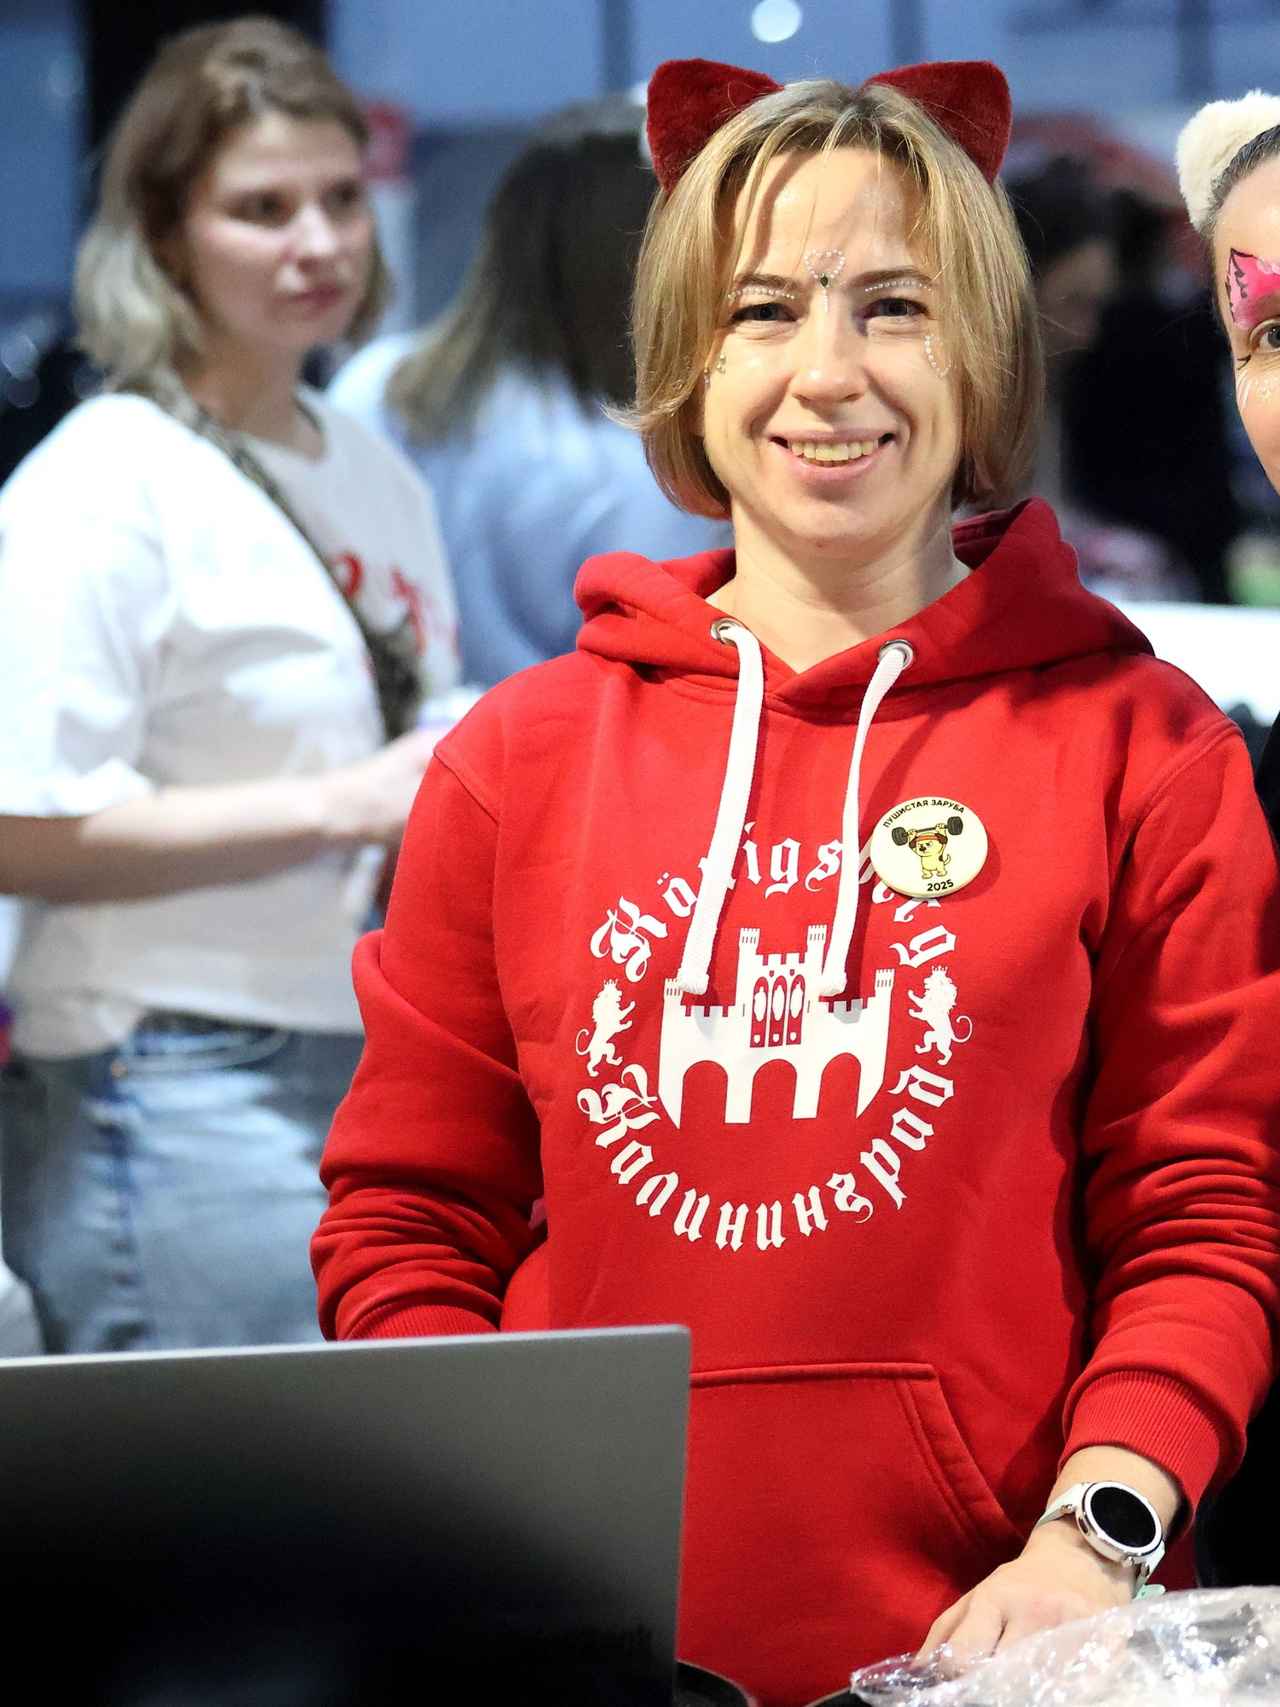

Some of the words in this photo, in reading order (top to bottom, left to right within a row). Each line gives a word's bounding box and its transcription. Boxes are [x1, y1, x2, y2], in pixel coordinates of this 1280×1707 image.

[882, 799, 930, 829] ПУШИСТАЯ
[931, 799, 965, 814] ЗАРУБА
[589, 820, 957, 984] Köigsrg
[926, 878, 955, 892] 2025
[577, 1063, 955, 1253] Калининград
